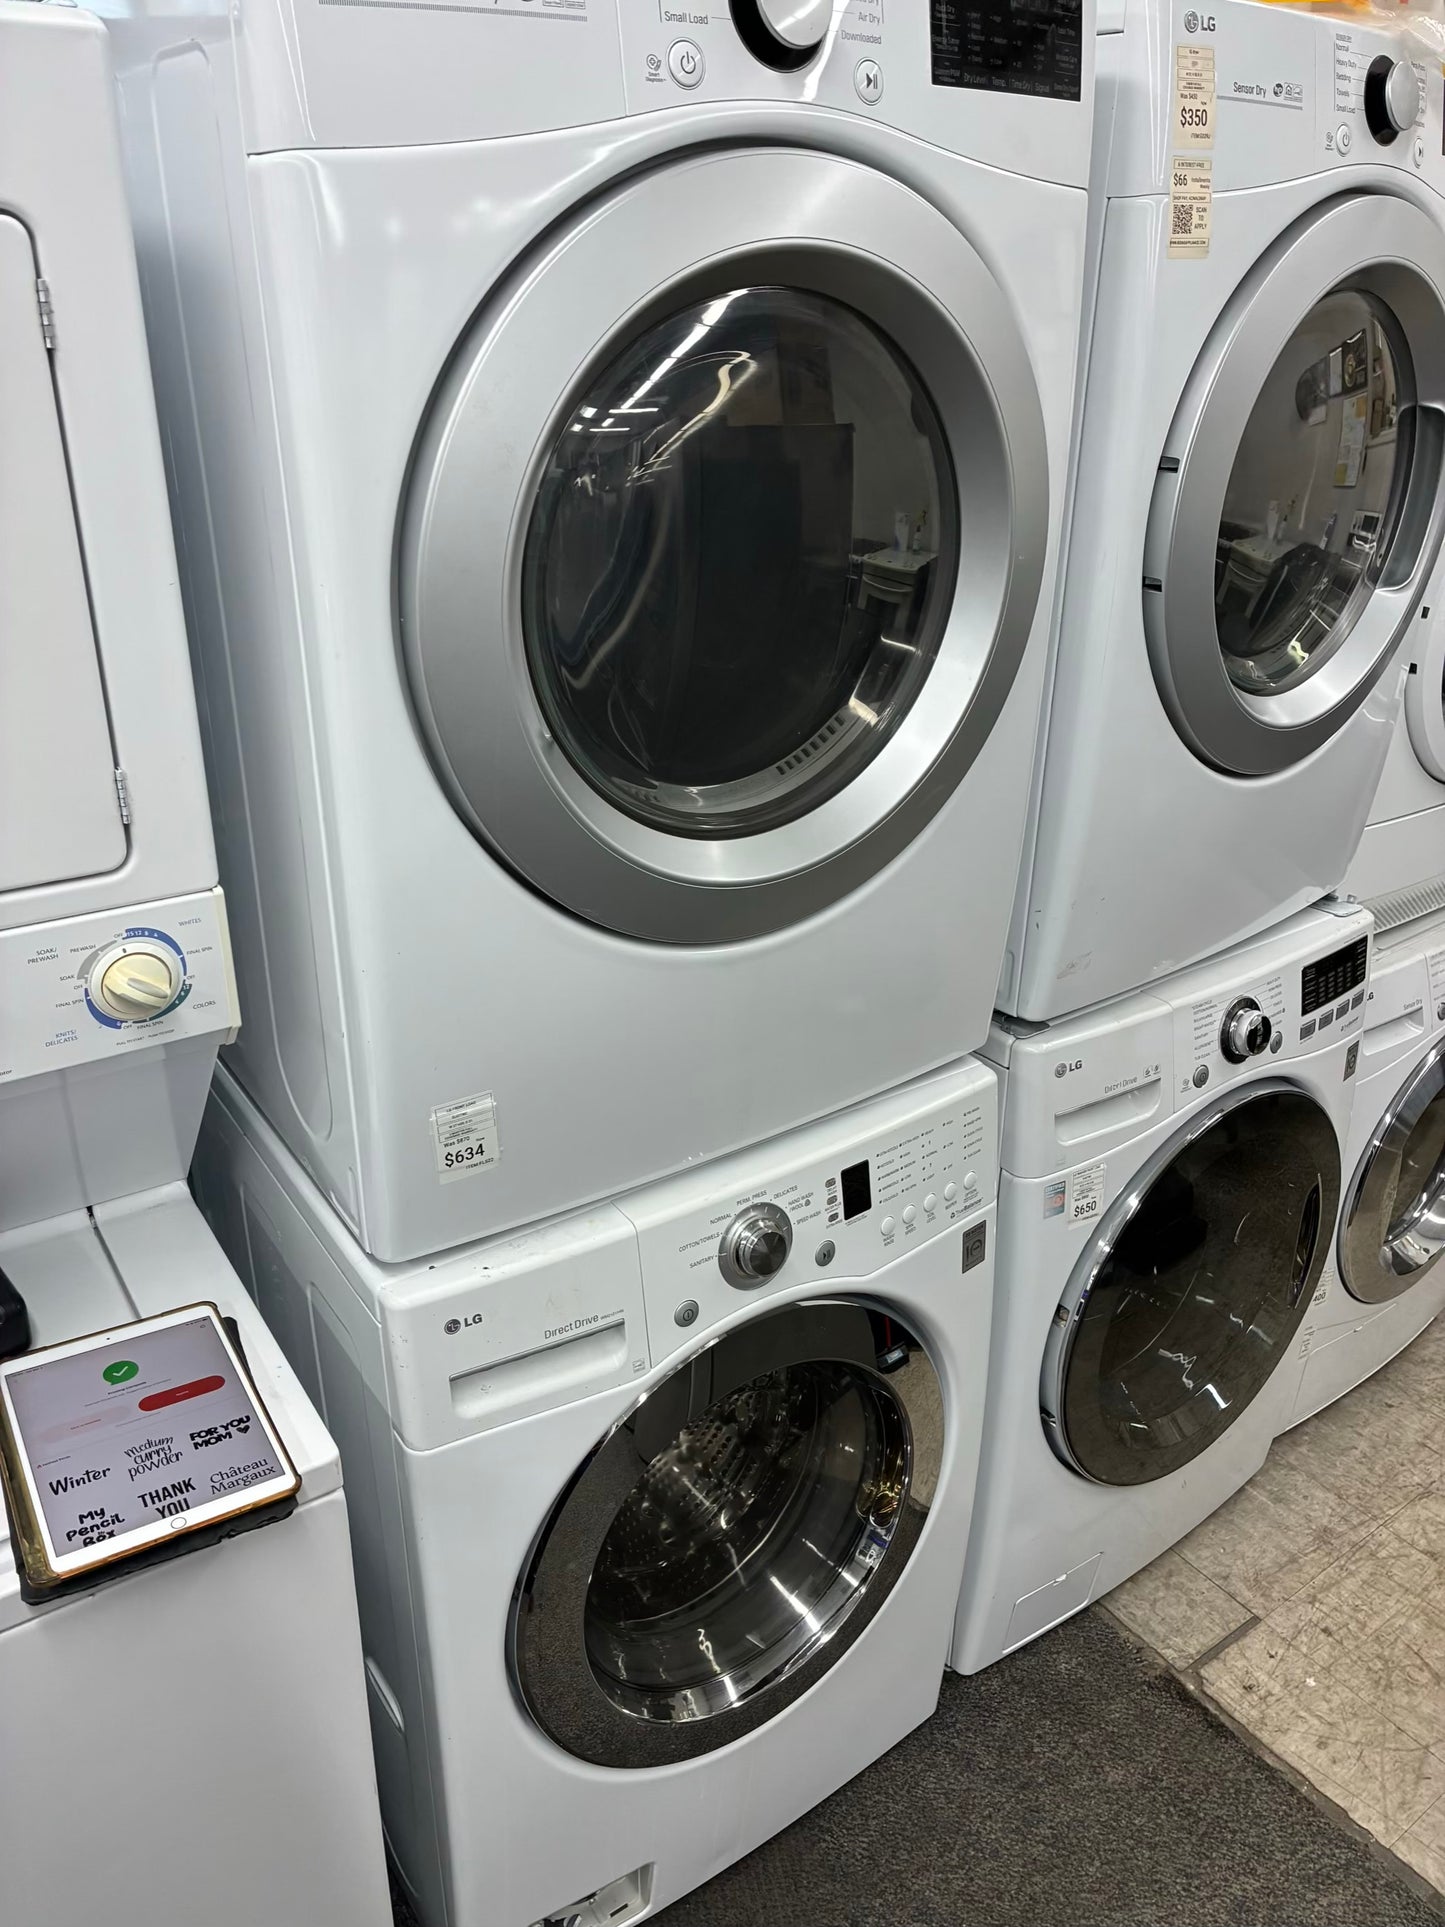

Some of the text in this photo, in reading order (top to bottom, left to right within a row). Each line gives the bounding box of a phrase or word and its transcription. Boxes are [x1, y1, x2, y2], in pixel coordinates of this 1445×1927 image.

[664, 11, 708, 25] Small Load
[858, 12, 880, 26] Air Dry
[841, 30, 882, 45] Downloaded
[1233, 82, 1267, 98] Sensor Dry
[1336, 104, 1356, 114] Small Load
[1180, 106, 1208, 128] $350
[1173, 172, 1188, 187] $66
[178, 918, 202, 927] WHITES
[36, 947, 57, 956] SOAK/
[69, 944, 96, 954] PREWASH
[186, 948, 202, 956] FINAL
[27, 954, 59, 965] PREWASH
[59, 974, 75, 982] SOAK
[55, 998, 84, 1009] FINAL SPIN
[192, 1000, 216, 1010] COLORS
[137, 1020, 164, 1030] FINAL SPIN
[45, 1035, 79, 1048] DELICATES
[55, 1029, 77, 1039] KNITS/
[1122, 1076, 1138, 1087] Drive
[444, 1143, 485, 1168] $634
[751, 1190, 767, 1200] PRESS
[773, 1185, 798, 1200] DELICATES
[788, 1192, 814, 1206] HAND WASH
[1074, 1200, 1097, 1218] $650
[710, 1213, 733, 1225] NORMAL
[796, 1211, 822, 1225] SPEED WASH
[678, 1232, 721, 1253] COTTON/TOWELS
[689, 1254, 714, 1269] SANITARY
[544, 1314, 599, 1340] Direct Drive
[189, 1414, 251, 1442] FOR YOU
[193, 1431, 233, 1451] MOM
[133, 1444, 172, 1465] curry
[128, 1451, 183, 1482] powder
[210, 1458, 269, 1485] Château
[48, 1466, 111, 1497] Winter
[211, 1465, 277, 1495] Margaux
[137, 1477, 197, 1509] THANK
[155, 1497, 191, 1520] YOU
[78, 1508, 106, 1525] My
